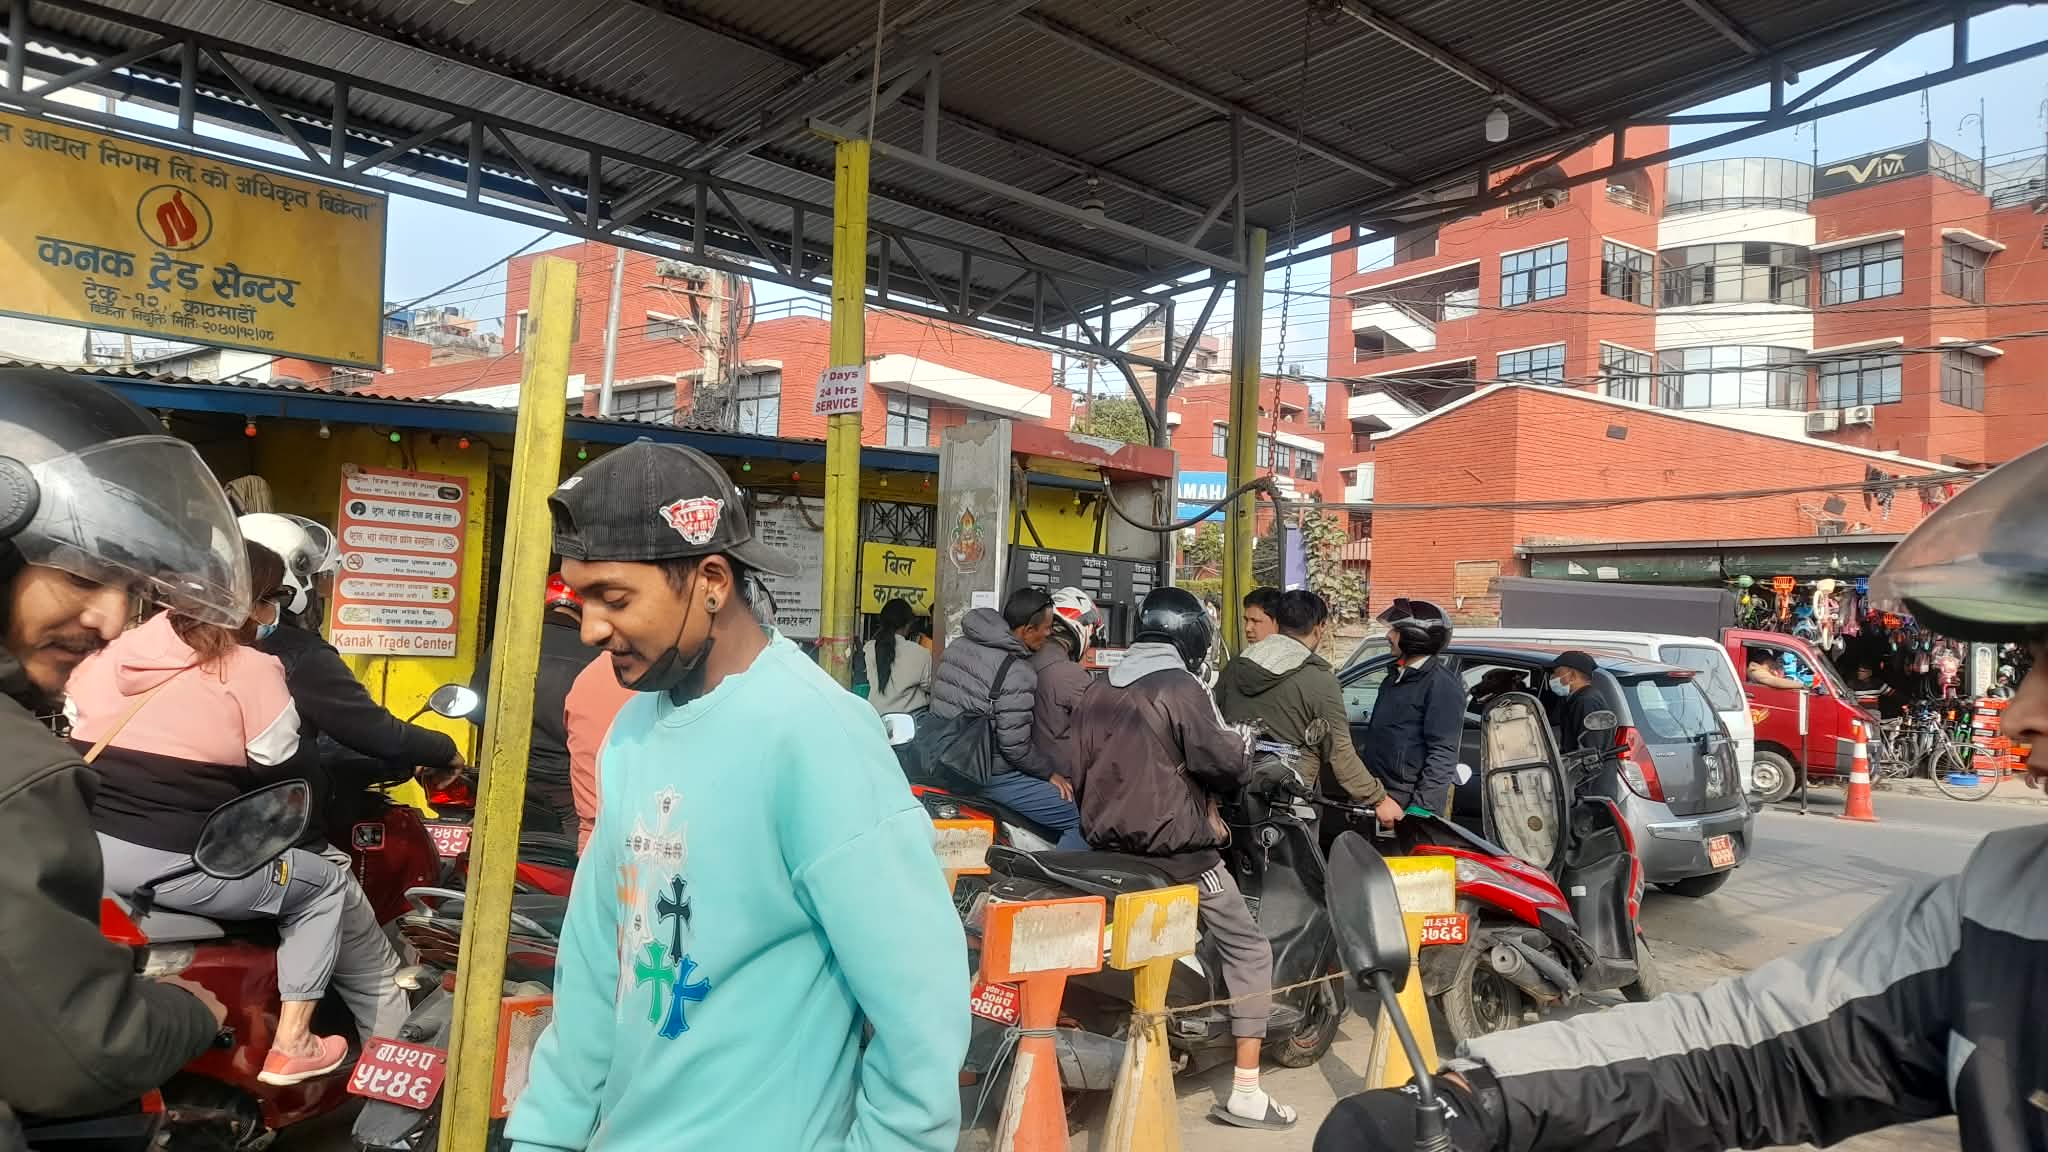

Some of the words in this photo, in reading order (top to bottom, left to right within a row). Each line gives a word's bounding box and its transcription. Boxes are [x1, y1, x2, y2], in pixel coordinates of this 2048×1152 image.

[23, 127, 91, 161] आयल
[98, 138, 161, 177] निगम
[235, 173, 312, 212] अधिकृत
[36, 235, 136, 278] कनक
[146, 251, 204, 294] ट्रेड
[212, 262, 302, 308] सेन्टर
[830, 371, 859, 382] Days
[819, 387, 832, 398] 24
[835, 385, 857, 395] Hrs
[815, 397, 858, 413] SERVICE
[882, 550, 917, 577] बिल
[334, 633, 374, 648] Kanak
[377, 634, 411, 649] Trade
[414, 635, 454, 651] Center
